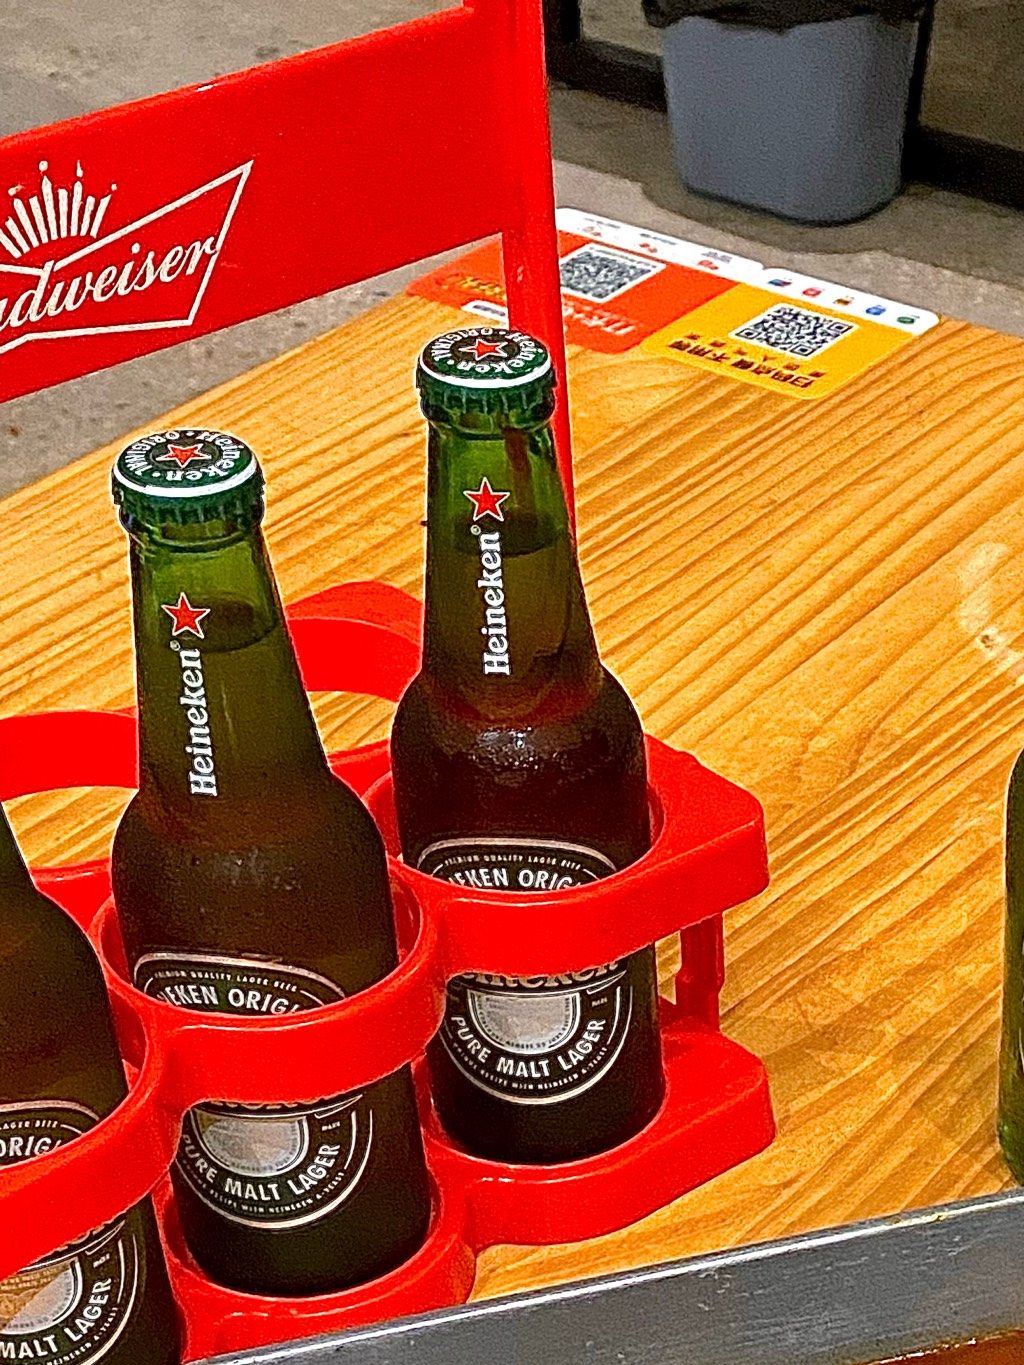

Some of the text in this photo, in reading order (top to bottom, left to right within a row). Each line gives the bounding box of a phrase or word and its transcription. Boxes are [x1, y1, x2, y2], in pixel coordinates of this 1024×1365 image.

[0, 236, 218, 332] dweiser
[457, 332, 544, 374] Heineken
[166, 431, 245, 480] Heineken
[478, 531, 511, 676] Heineken
[180, 645, 218, 797] Heineken
[451, 1016, 491, 1063] PURE
[496, 1057, 550, 1078] MALT
[557, 1019, 606, 1070] LAGER
[225, 1178, 280, 1201] MALT
[287, 1144, 340, 1195] LAGER
[64, 1278, 112, 1342] LAGER
